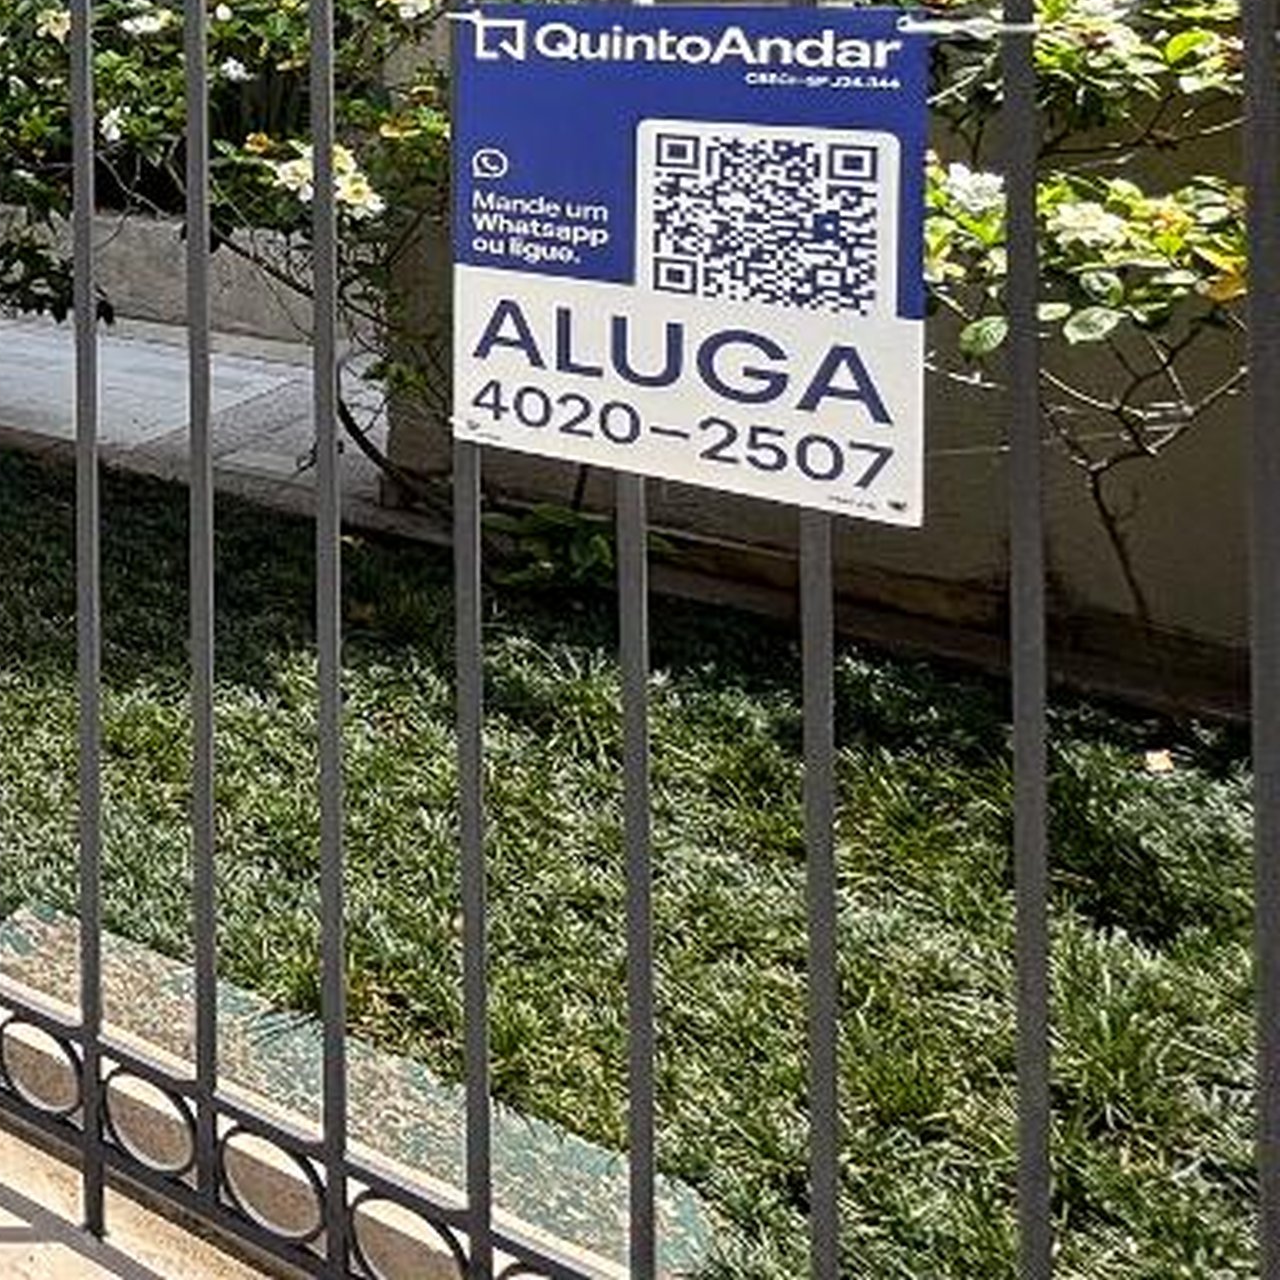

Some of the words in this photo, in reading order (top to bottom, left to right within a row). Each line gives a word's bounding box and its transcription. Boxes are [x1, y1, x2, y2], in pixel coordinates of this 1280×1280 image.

[535, 22, 902, 69] QuintoAndar
[473, 190, 560, 218] Mande
[566, 202, 609, 222] um
[472, 213, 609, 247] Whatsapp
[472, 237, 505, 255] ou
[509, 237, 581, 264] ligue.
[472, 299, 894, 427] ALUGA
[472, 379, 895, 490] 4020-2507
